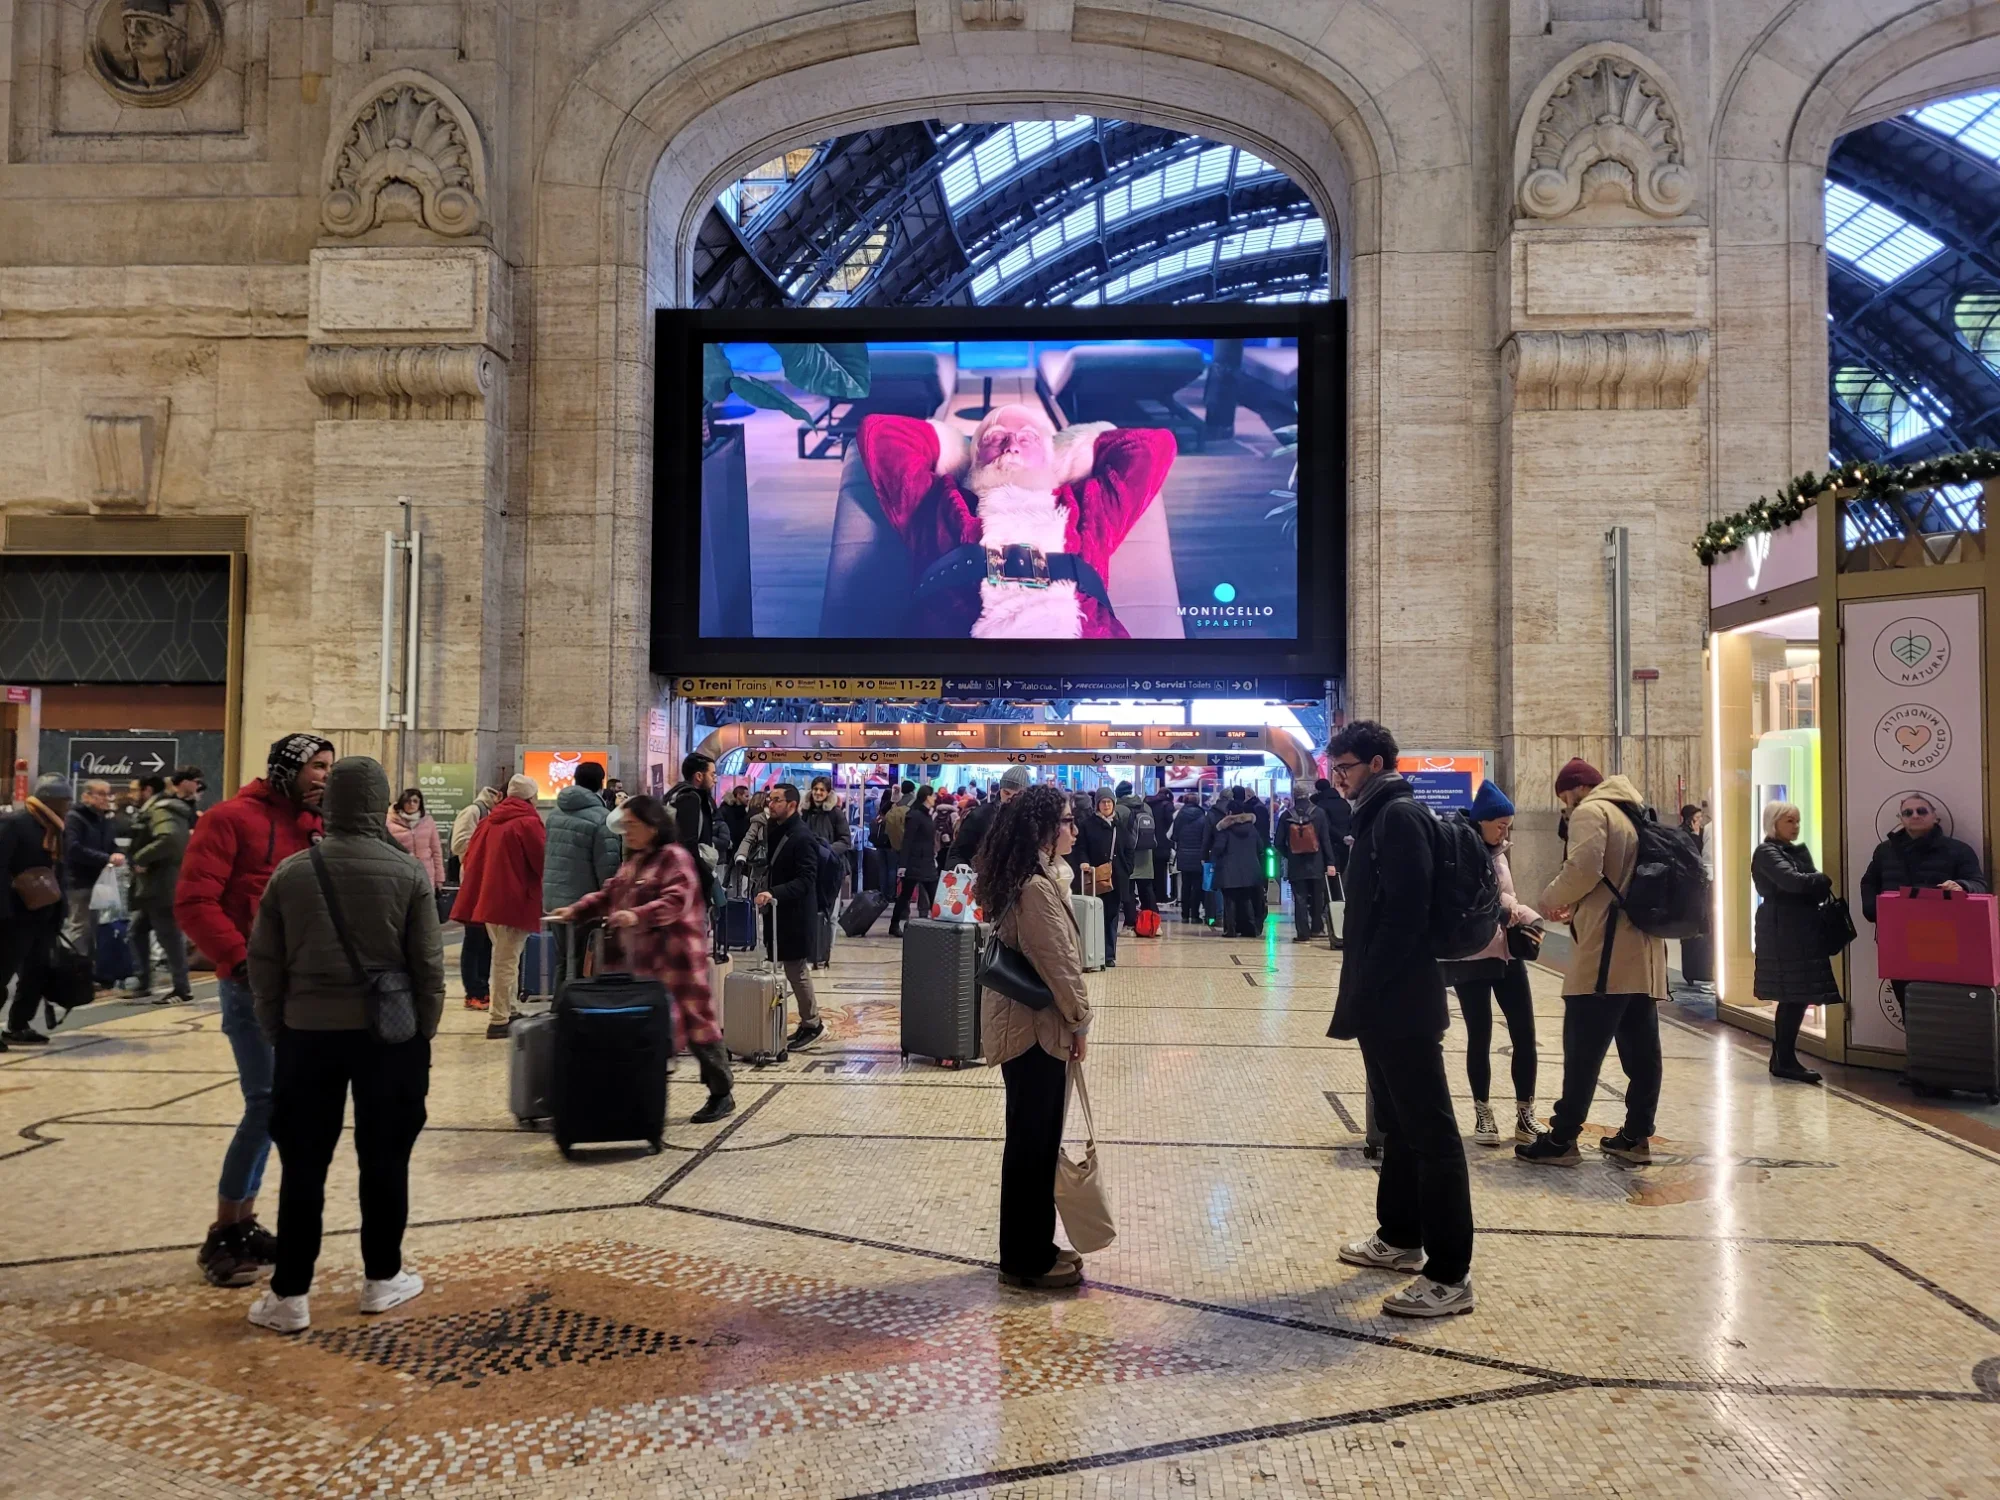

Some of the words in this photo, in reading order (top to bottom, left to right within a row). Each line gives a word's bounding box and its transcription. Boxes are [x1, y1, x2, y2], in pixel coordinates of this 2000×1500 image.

[1177, 606, 1273, 616] MONTICELLO
[1902, 647, 1945, 681] NATURAL
[699, 679, 732, 691] Treni
[736, 679, 767, 691] Trains
[819, 680, 847, 690] 1-10
[900, 680, 937, 690] 11-22
[1155, 681, 1187, 689] Servizi
[1188, 681, 1212, 689] Toilets
[1882, 708, 1940, 734] MINDFULLY
[1902, 728, 1946, 768] PRODUCED
